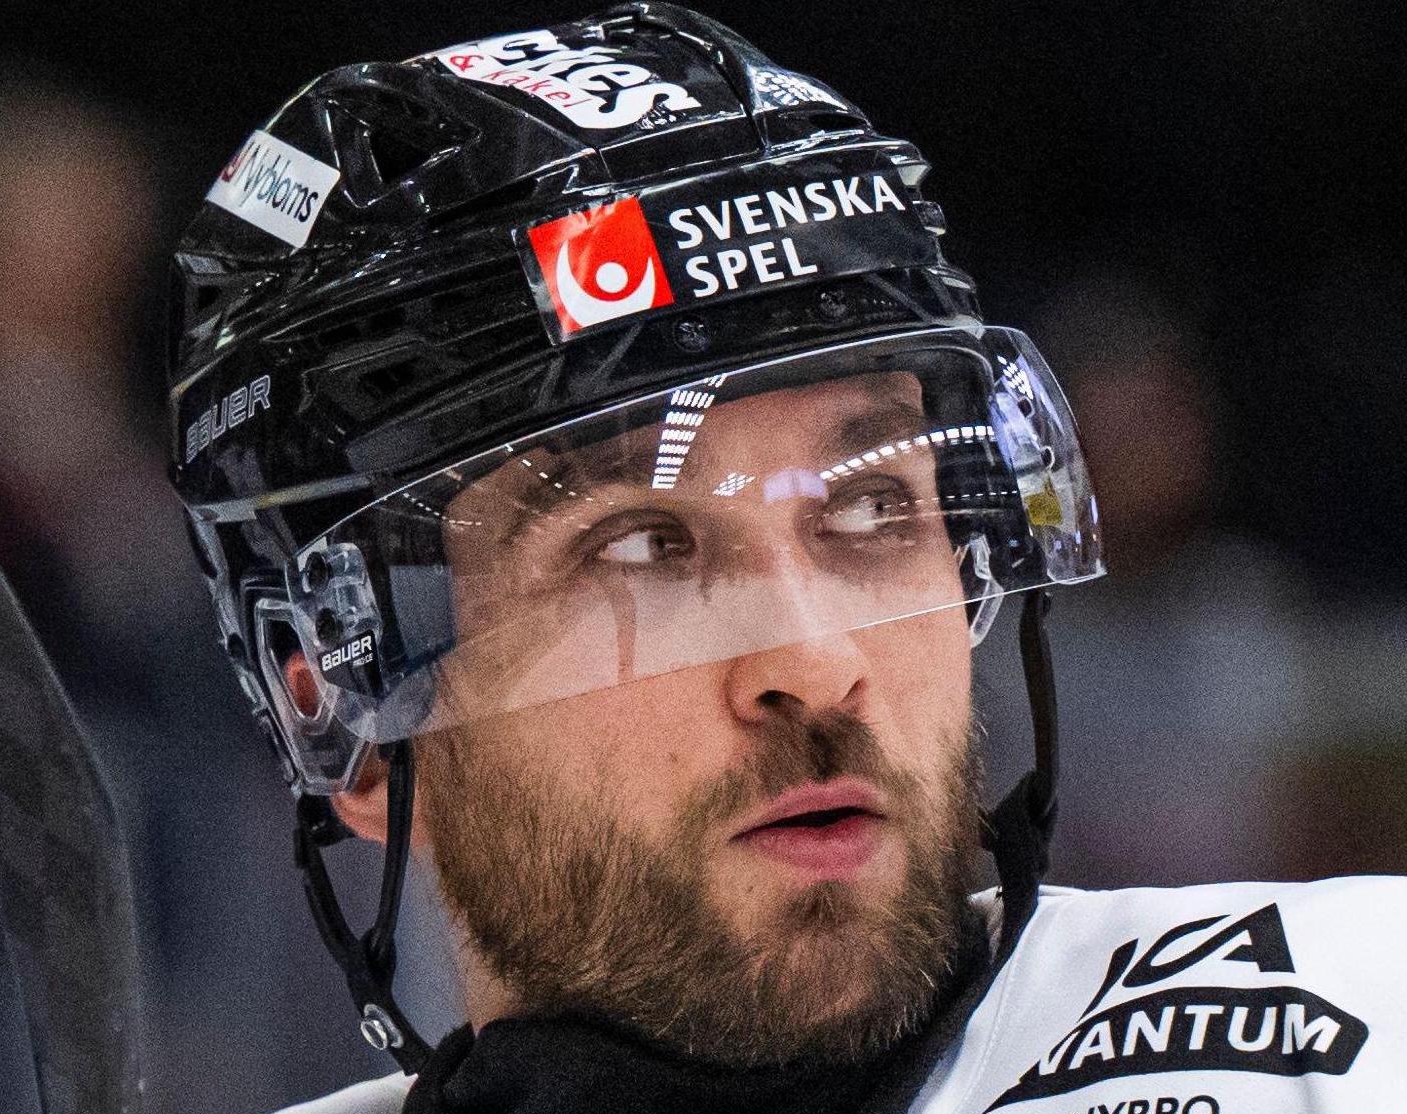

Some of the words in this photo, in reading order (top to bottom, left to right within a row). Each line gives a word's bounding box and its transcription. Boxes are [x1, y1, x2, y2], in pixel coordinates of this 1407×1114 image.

[669, 175, 905, 249] SVENSKA
[686, 238, 818, 298] SPEL
[1074, 902, 1296, 1023] ICA
